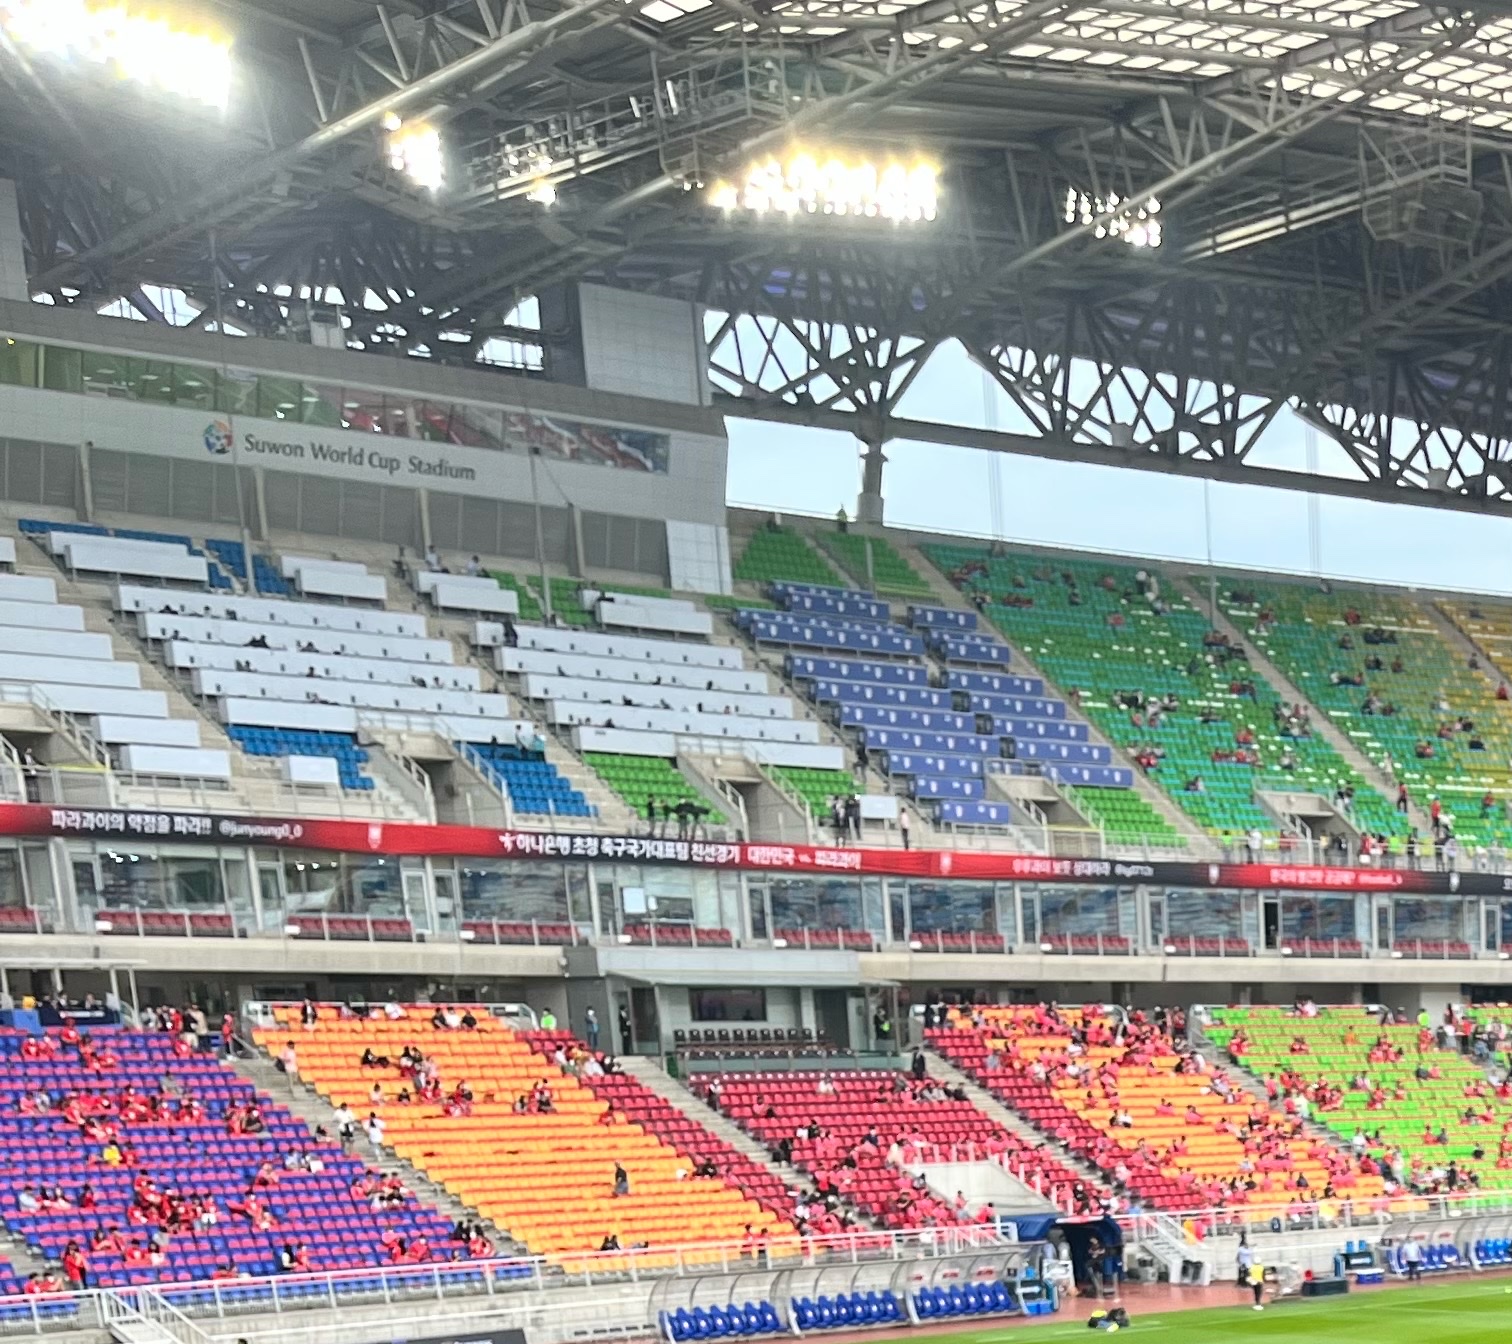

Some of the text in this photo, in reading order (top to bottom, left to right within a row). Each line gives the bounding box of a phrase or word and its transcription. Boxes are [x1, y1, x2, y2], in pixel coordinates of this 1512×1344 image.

[244, 433, 476, 481] Suwon World Cup Stadium
[51, 809, 125, 832] 파라과이의
[516, 833, 572, 856] 하나은행
[573, 836, 599, 857] 초청
[600, 837, 690, 861] 축구국가대표팀
[692, 841, 740, 864] 친선경기
